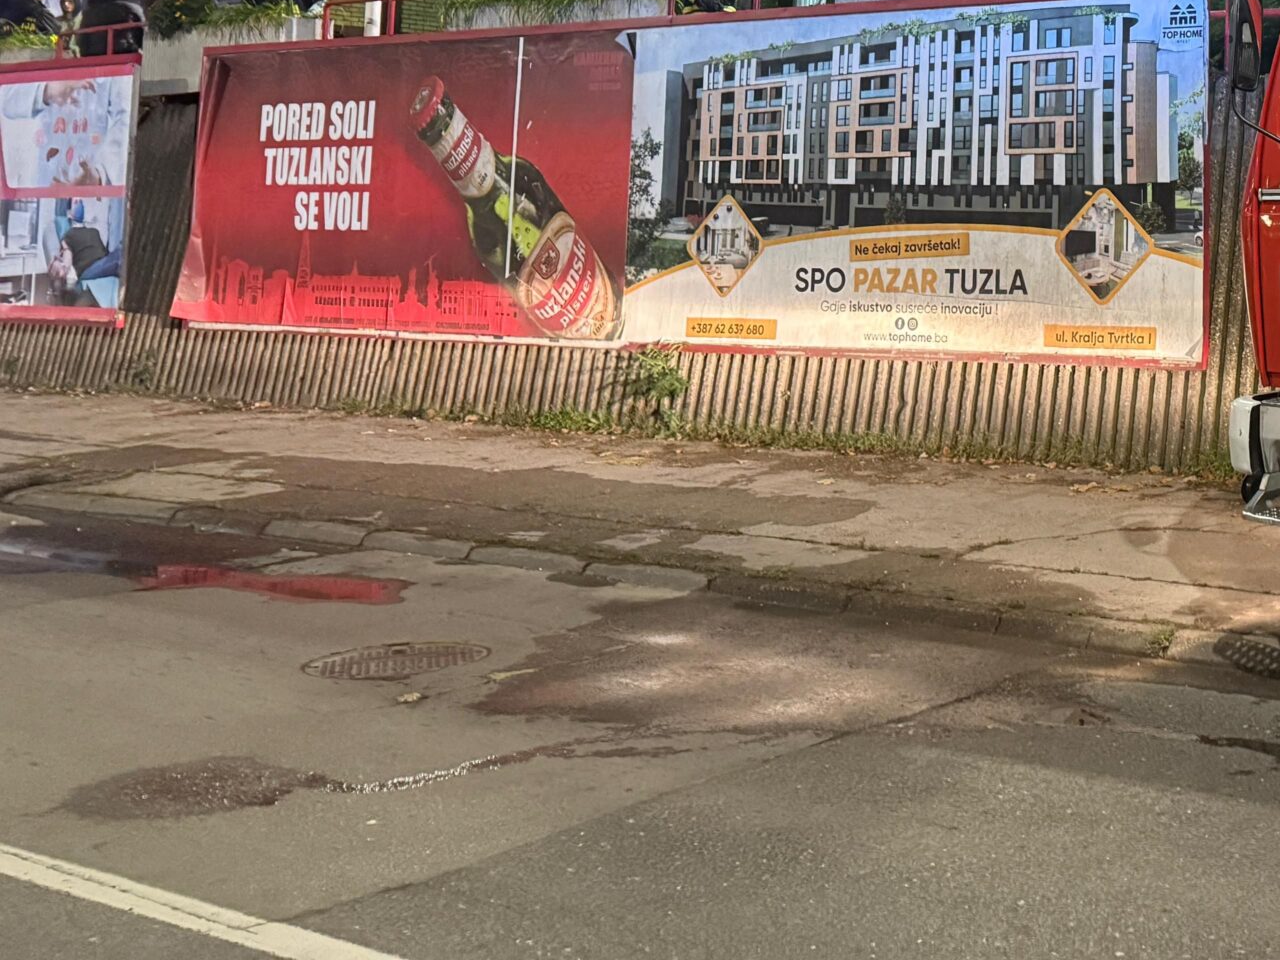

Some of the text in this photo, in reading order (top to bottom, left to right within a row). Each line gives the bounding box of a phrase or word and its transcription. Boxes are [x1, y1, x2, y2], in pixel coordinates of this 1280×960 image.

[1162, 29, 1203, 39] TOP HOME
[260, 100, 376, 142] PORED SOLI
[264, 145, 373, 186] TUZLANSKI
[294, 190, 370, 231] SE VOLI
[855, 238, 961, 256] Ne čekaj završetak!
[535, 234, 586, 320] tuzlanski
[795, 267, 1028, 295] SPO PAZAR TUZLA
[560, 270, 593, 328] pilsner
[820, 300, 847, 315] Gdje
[849, 300, 893, 314] iskustvo
[895, 301, 938, 315] susreće
[940, 302, 992, 318] inovaciju
[691, 323, 764, 335] +387 62 639 680
[863, 331, 948, 343] www.tophome.ba
[1055, 330, 1068, 343] ul.
[1071, 331, 1104, 346] Kralja
[1107, 332, 1144, 344] Tvrtka
